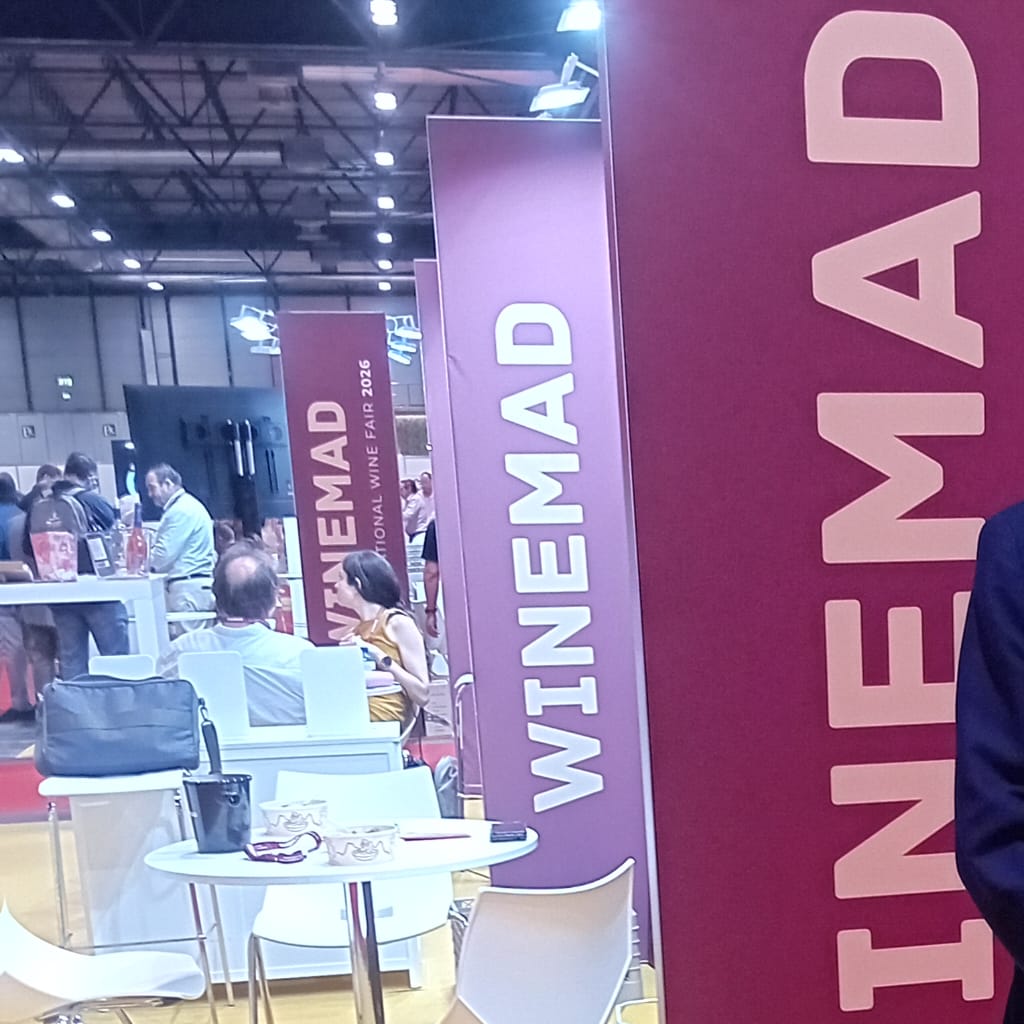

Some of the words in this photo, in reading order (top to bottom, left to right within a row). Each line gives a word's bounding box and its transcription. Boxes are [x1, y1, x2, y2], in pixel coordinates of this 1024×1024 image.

[358, 359, 374, 397] 2026
[363, 402, 377, 440] FAIR
[368, 445, 382, 493] WINE
[371, 494, 388, 558] TIONAL
[494, 301, 604, 813] WINEMAD
